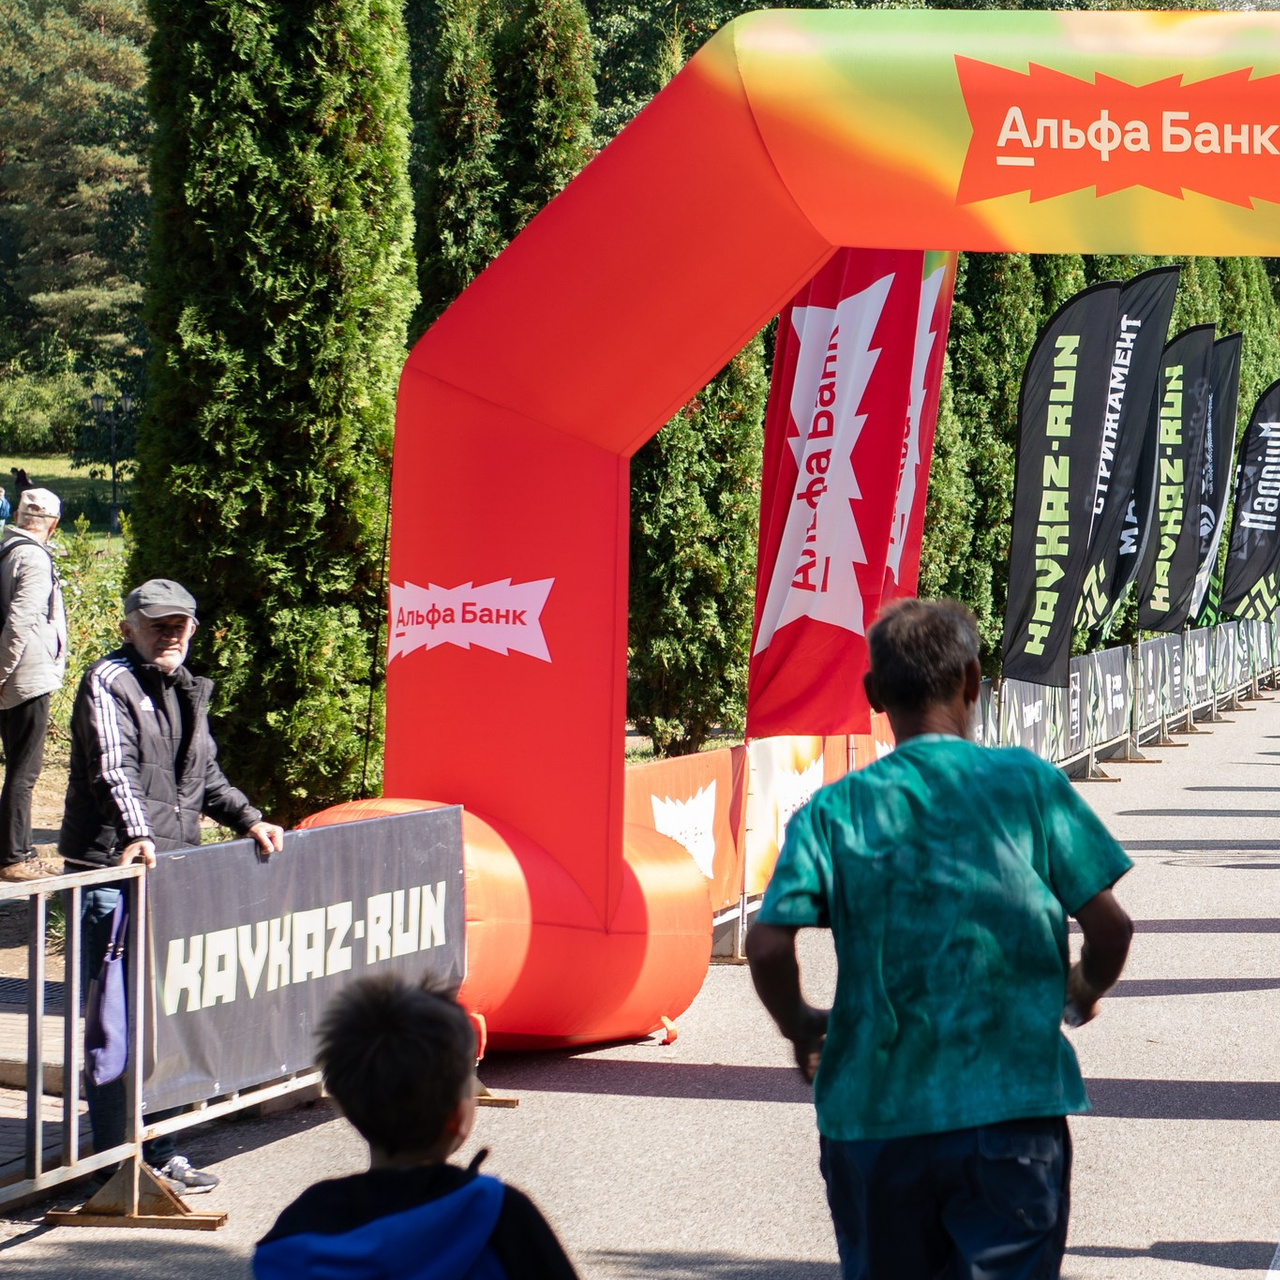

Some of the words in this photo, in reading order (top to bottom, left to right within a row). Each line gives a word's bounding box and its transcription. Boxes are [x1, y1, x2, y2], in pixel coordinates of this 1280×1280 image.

[996, 105, 1150, 166] Альфа
[1161, 110, 1280, 156] Банк
[1024, 335, 1080, 656] KAVKAZ-RUN
[1150, 364, 1184, 613] KAVKAZ-RUN
[395, 603, 456, 637] Альфа
[461, 601, 527, 626] Банк
[164, 880, 447, 1016] KAVKAZ-RUN
